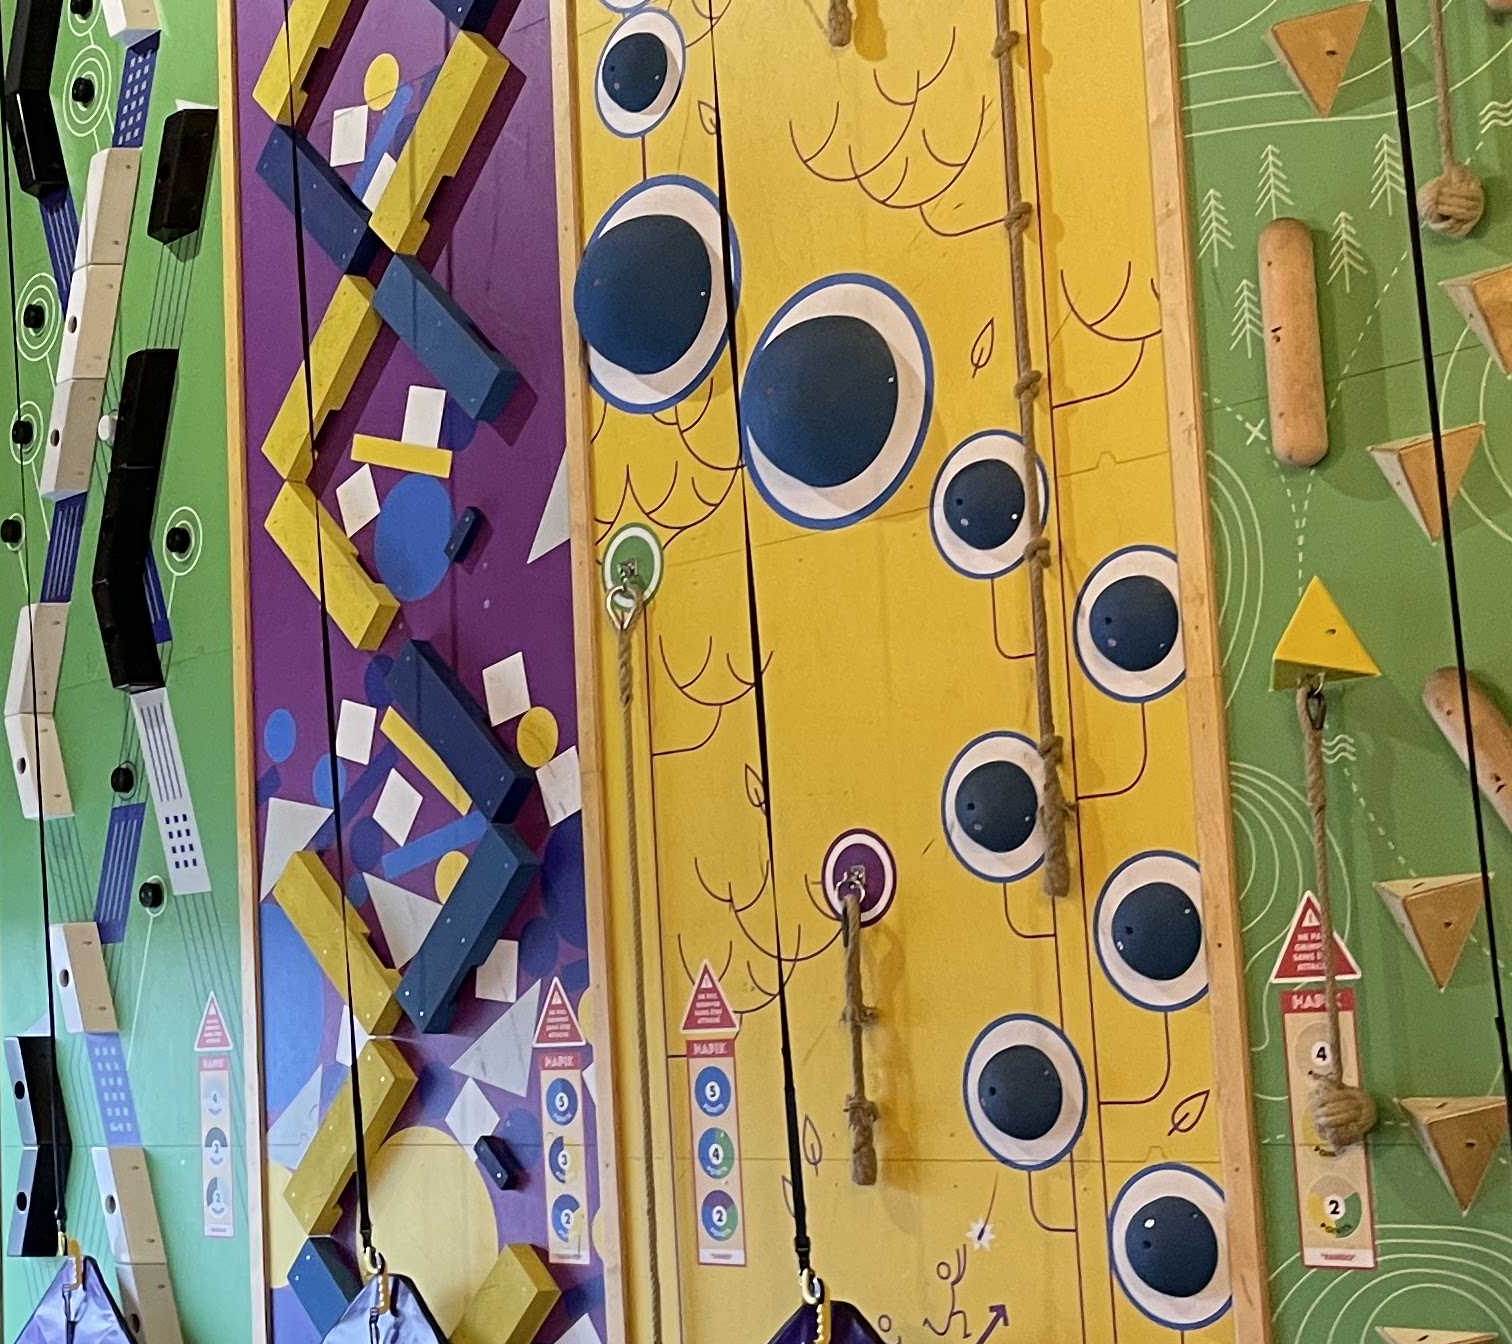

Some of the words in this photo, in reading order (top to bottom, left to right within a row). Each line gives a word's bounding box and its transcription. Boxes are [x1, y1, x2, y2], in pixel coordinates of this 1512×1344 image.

[1316, 1046, 1327, 1062] 4
[709, 1085, 717, 1098] 5
[558, 1096, 565, 1107] 5
[561, 1154, 568, 1166] 3
[712, 1147, 720, 1161] 4
[216, 1193, 221, 1203] 2
[1328, 1200, 1340, 1215] 2
[564, 1213, 571, 1225] 2
[715, 1209, 724, 1222] 2
